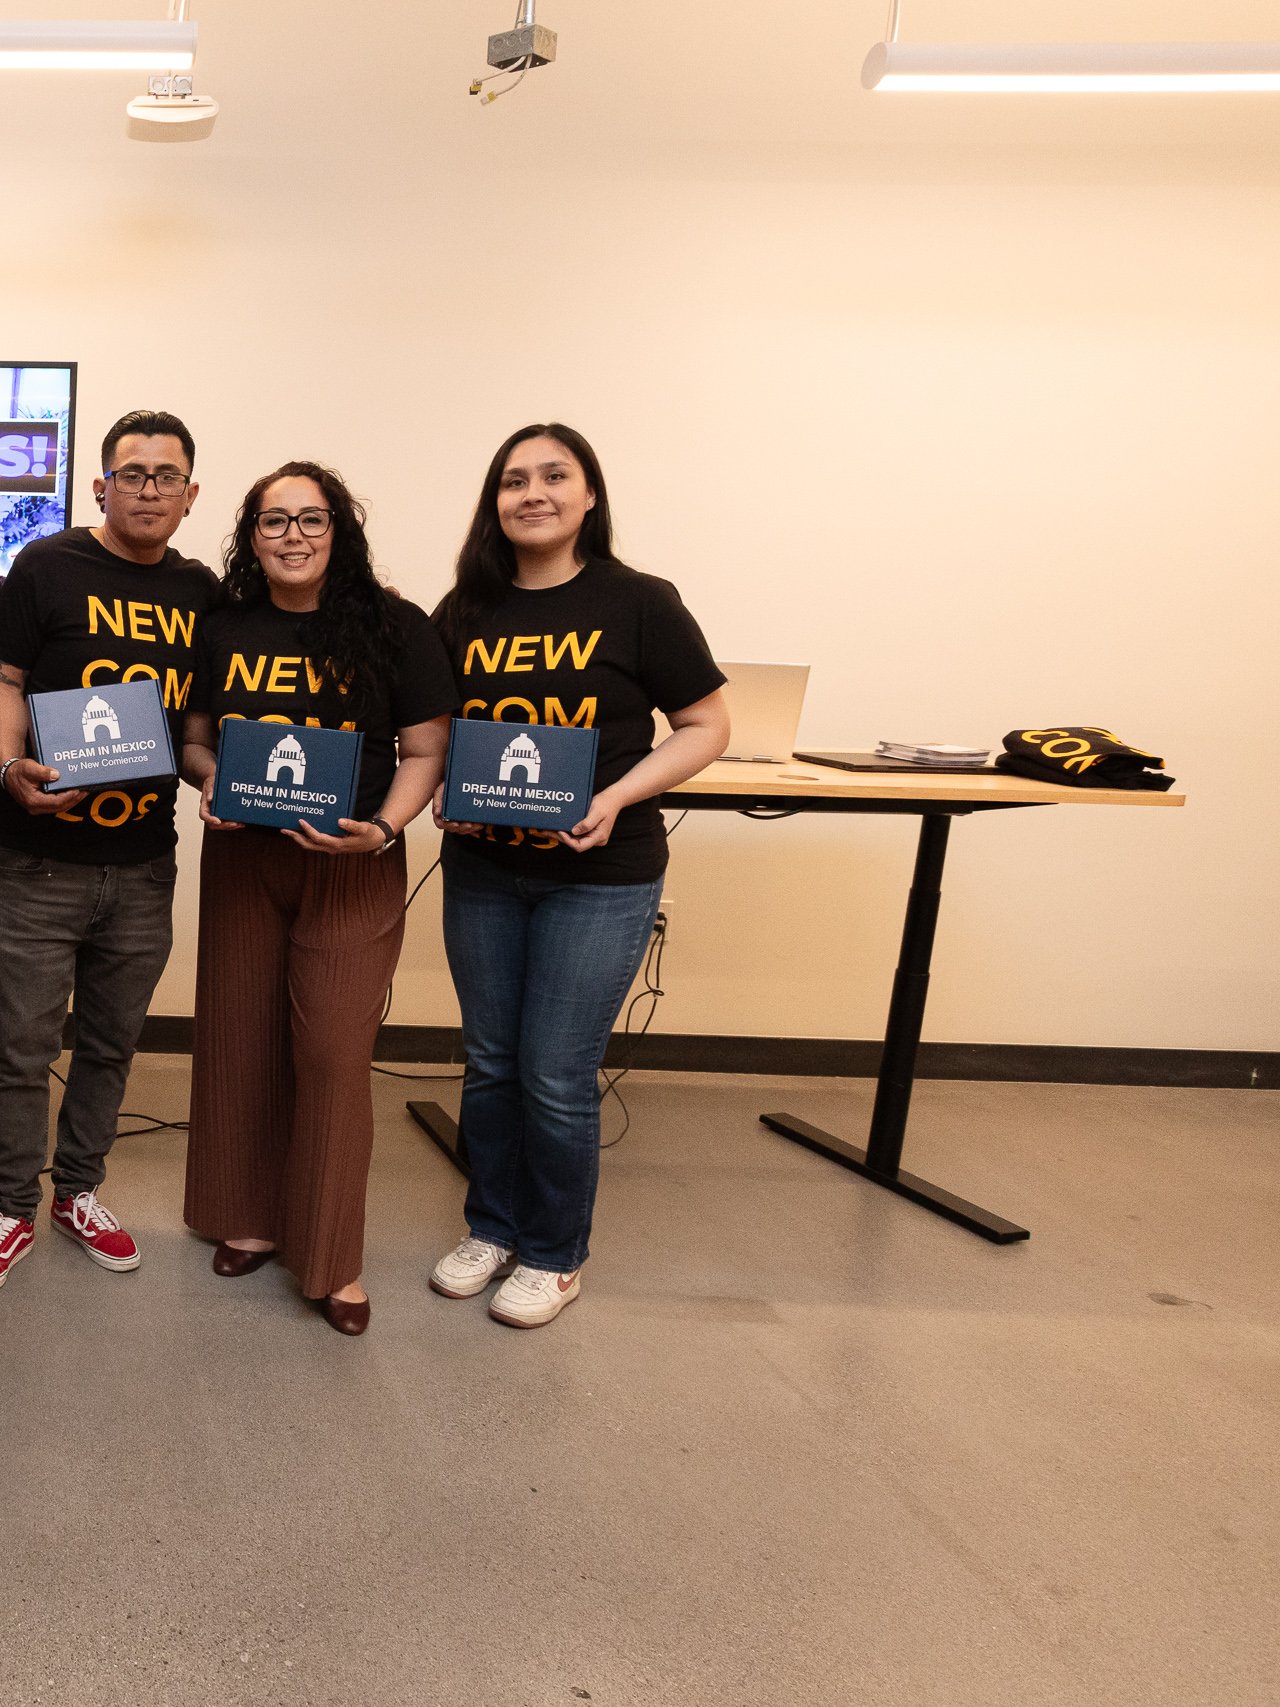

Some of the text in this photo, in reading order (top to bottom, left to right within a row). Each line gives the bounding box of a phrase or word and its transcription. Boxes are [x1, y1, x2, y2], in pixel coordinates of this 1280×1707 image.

[88, 595, 196, 648] NEW
[463, 630, 603, 675] NEW
[54, 740, 156, 762] DREAM IN MEXICO
[67, 754, 149, 773] by New Comienzos
[231, 782, 337, 805] DREAM IN MEXICO
[462, 782, 574, 802] DREAM IN MEXICO
[241, 796, 325, 816] by New Comienzos
[473, 797, 561, 814] by New Comienzos
